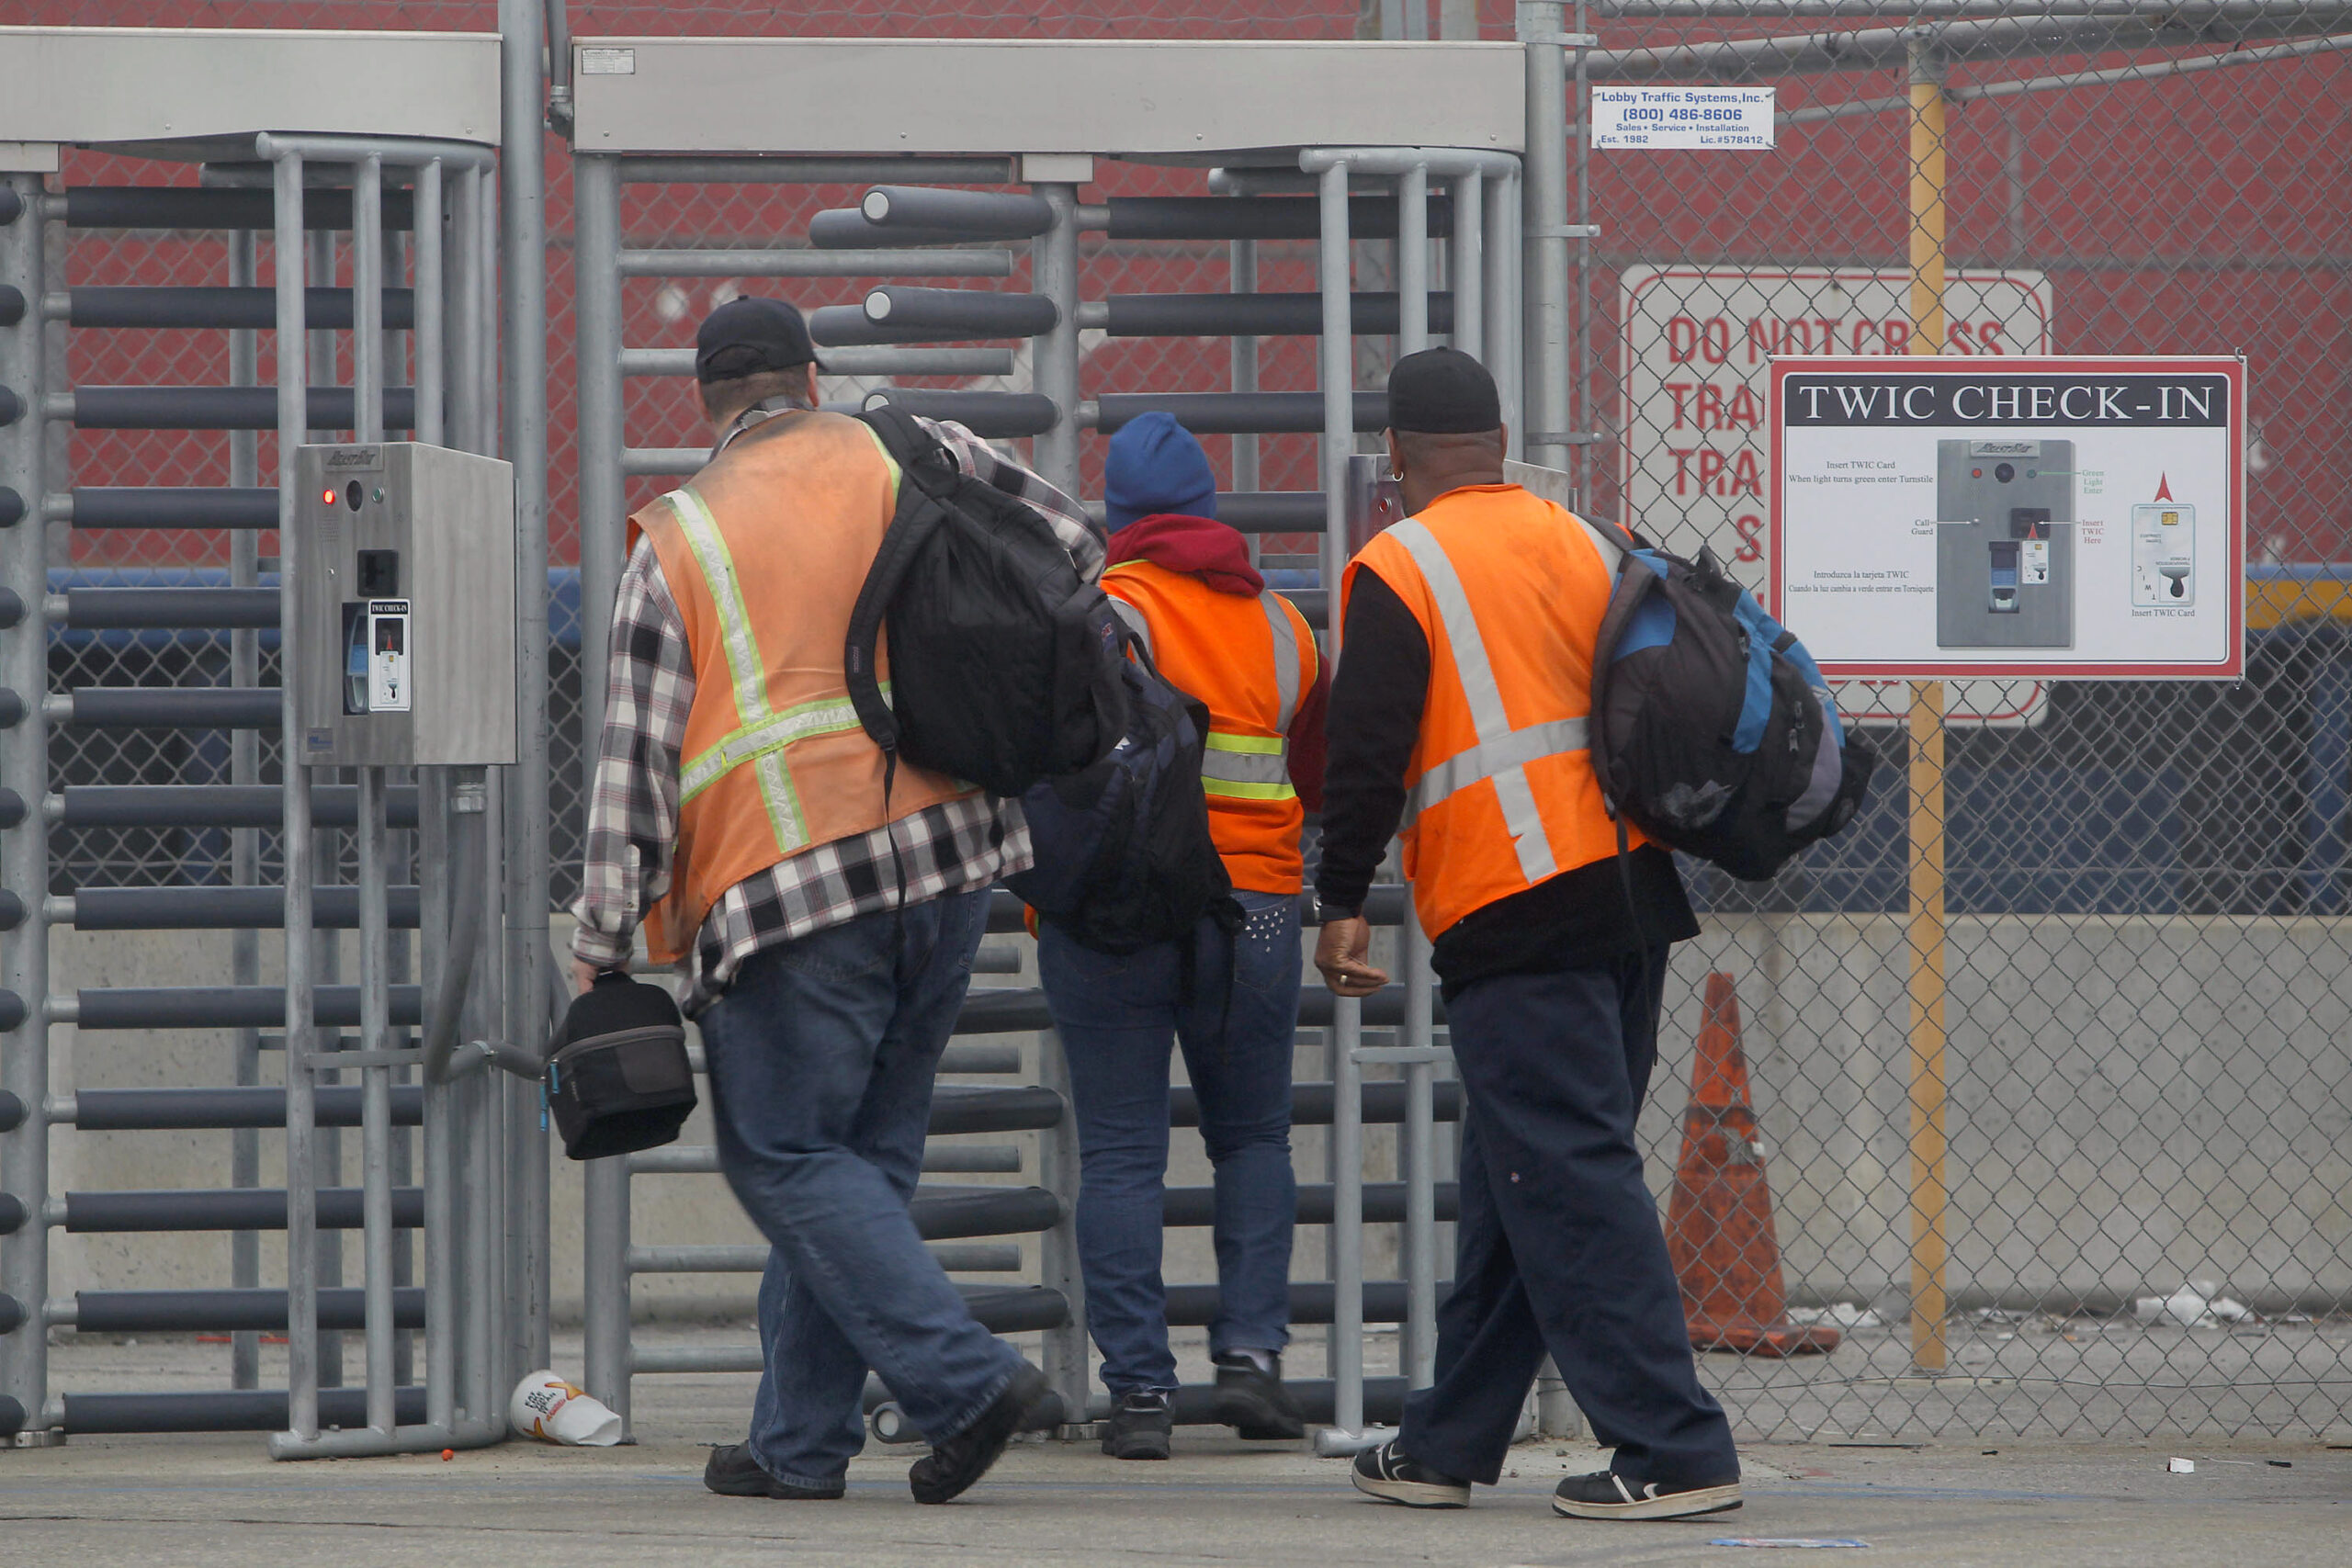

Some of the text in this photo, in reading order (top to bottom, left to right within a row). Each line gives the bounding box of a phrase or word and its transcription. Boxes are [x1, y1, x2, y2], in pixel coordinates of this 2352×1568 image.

[1601, 92, 1637, 105] Lobby
[1641, 92, 1680, 103] Traffic
[1623, 107, 1743, 122] (800) 486-8606
[1616, 123, 1749, 132] Sales Service Installation
[1600, 135, 1648, 143] Est. 1982
[1668, 317, 2005, 365] DO NOT CRSS
[1799, 386, 2214, 420] TWIC CHECK-IN
[1826, 460, 1896, 469] Insert TWIC Card
[1789, 474, 1934, 485] When light turns green enter Turnstile
[2083, 478, 2103, 487] Light
[1911, 527, 1934, 536] Guard
[1854, 570, 1860, 579] la
[1861, 570, 1884, 581] tarjeta
[1886, 570, 1910, 579] TWIC
[2132, 609, 2196, 617] Insert TWIC Card
